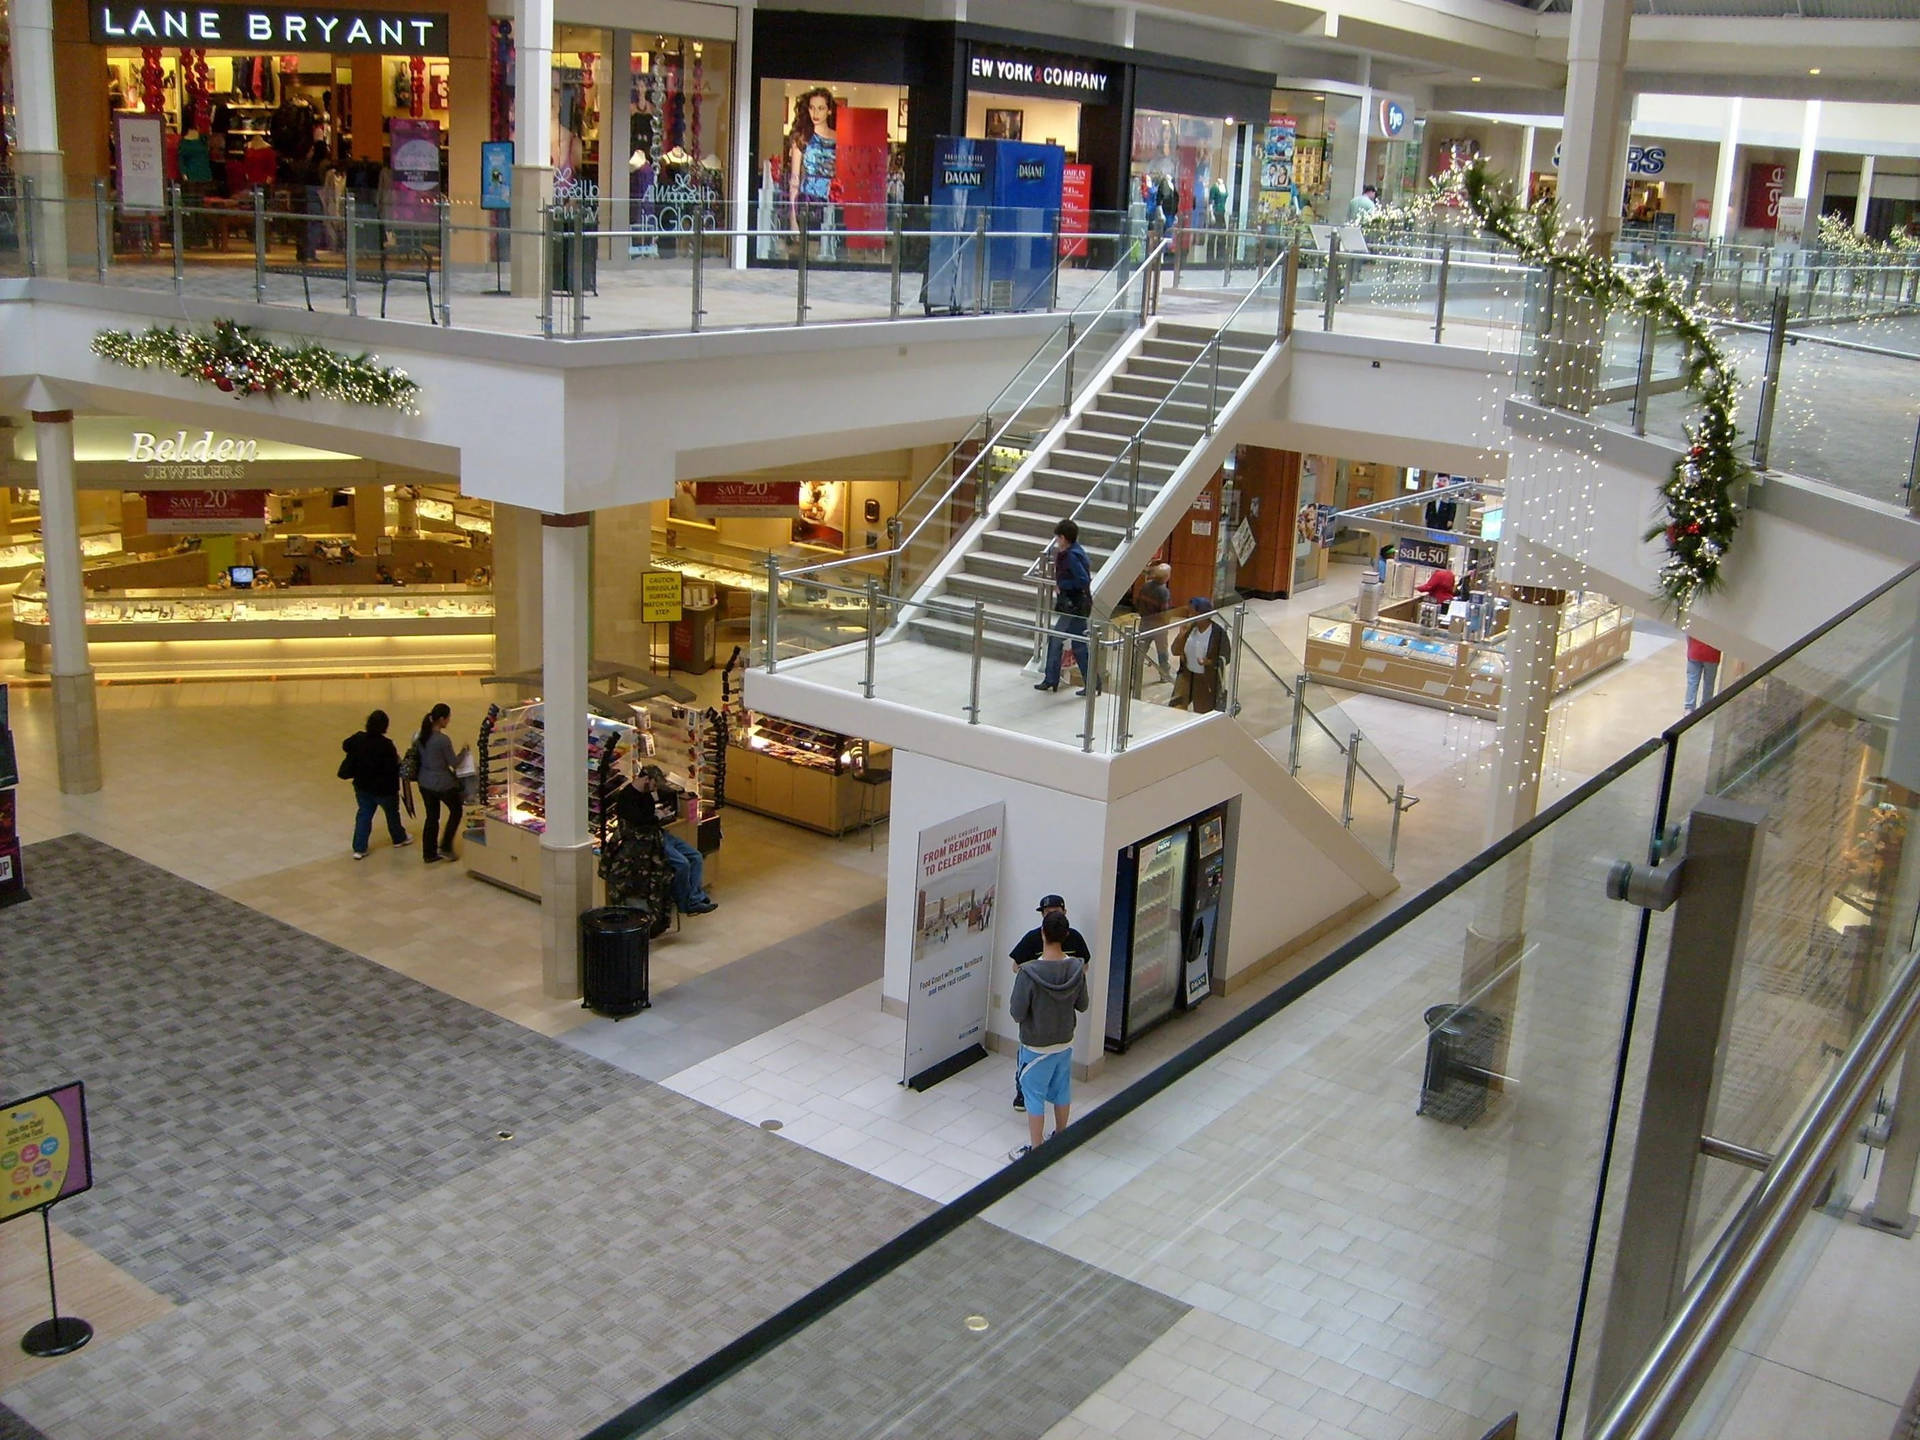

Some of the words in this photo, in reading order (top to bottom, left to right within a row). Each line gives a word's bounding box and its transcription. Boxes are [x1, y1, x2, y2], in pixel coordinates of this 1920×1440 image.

[104, 7, 222, 40] LANE
[248, 13, 434, 47] BRYANT
[996, 60, 1033, 83] YORK
[1043, 67, 1107, 91] COMPANY
[1389, 106, 1403, 130] fye
[944, 170, 982, 186] DASANI
[1018, 163, 1043, 179] DASANI
[1765, 167, 1785, 218] sale
[128, 430, 260, 463] Belden
[144, 464, 246, 480] JEWELERS
[717, 484, 744, 496] SAVE
[170, 496, 201, 509] SAVE
[1400, 545, 1427, 561] sale
[922, 846, 947, 865] FROM
[948, 826, 998, 854] RENOVATION
[925, 864, 936, 877] TO
[937, 841, 993, 872] CELEBRATION.
[920, 979, 931, 991] Food
